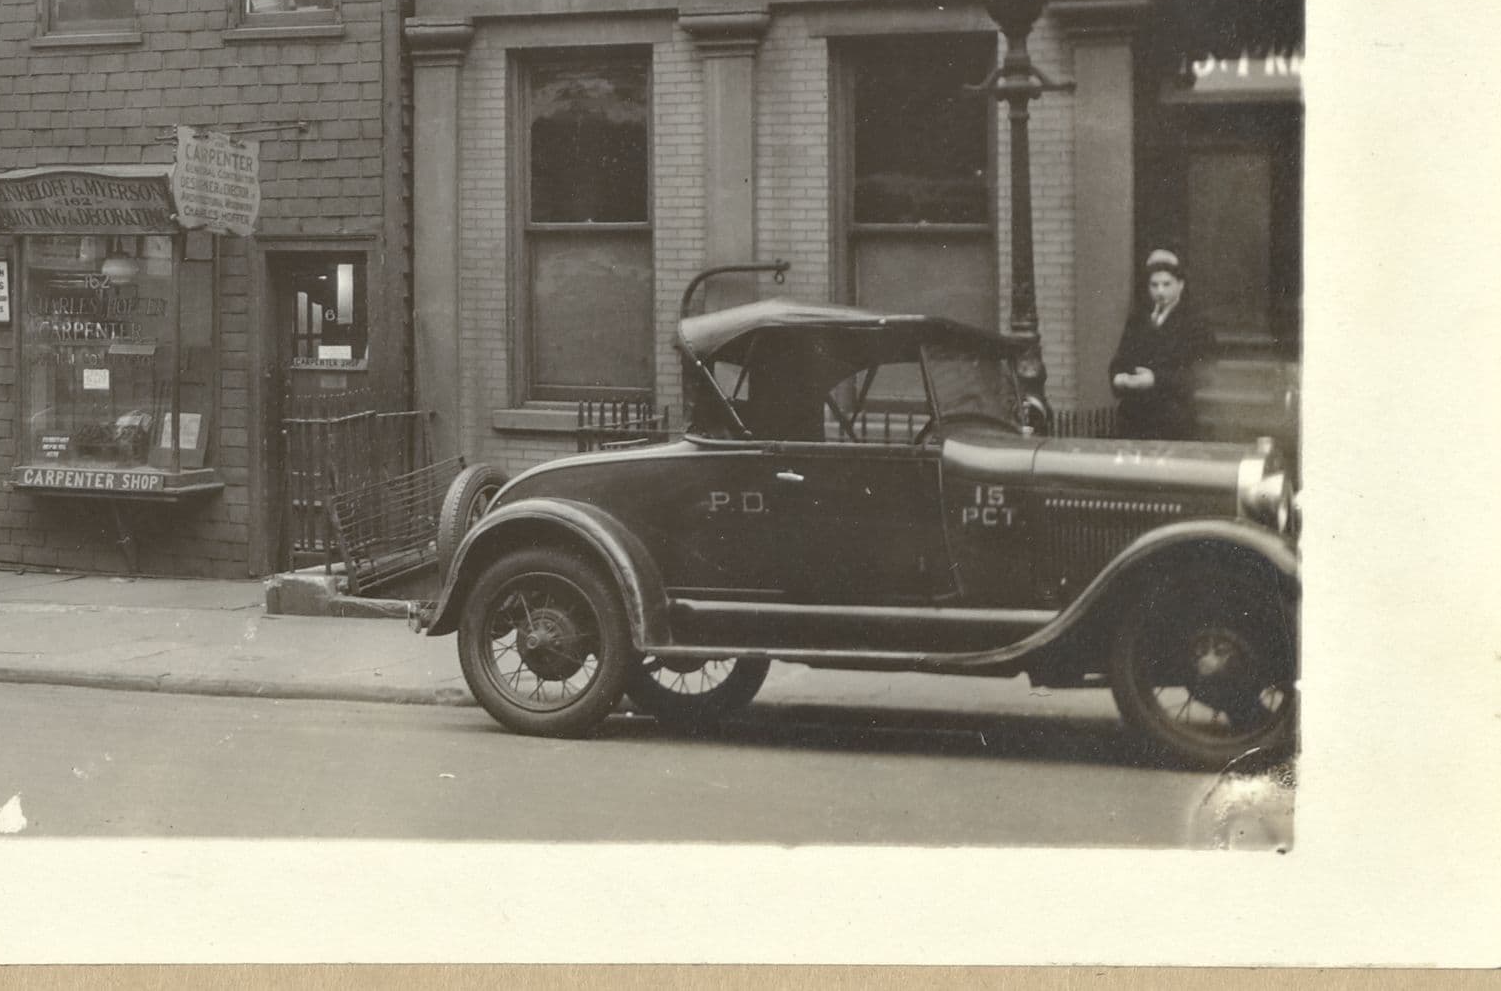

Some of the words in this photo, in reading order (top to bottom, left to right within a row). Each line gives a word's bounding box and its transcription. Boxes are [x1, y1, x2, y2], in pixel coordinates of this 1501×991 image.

[185, 142, 254, 172] CARPENTER
[24, 469, 115, 488] CARPENTER
[122, 474, 159, 489] SHOP
[975, 485, 1005, 506] 15
